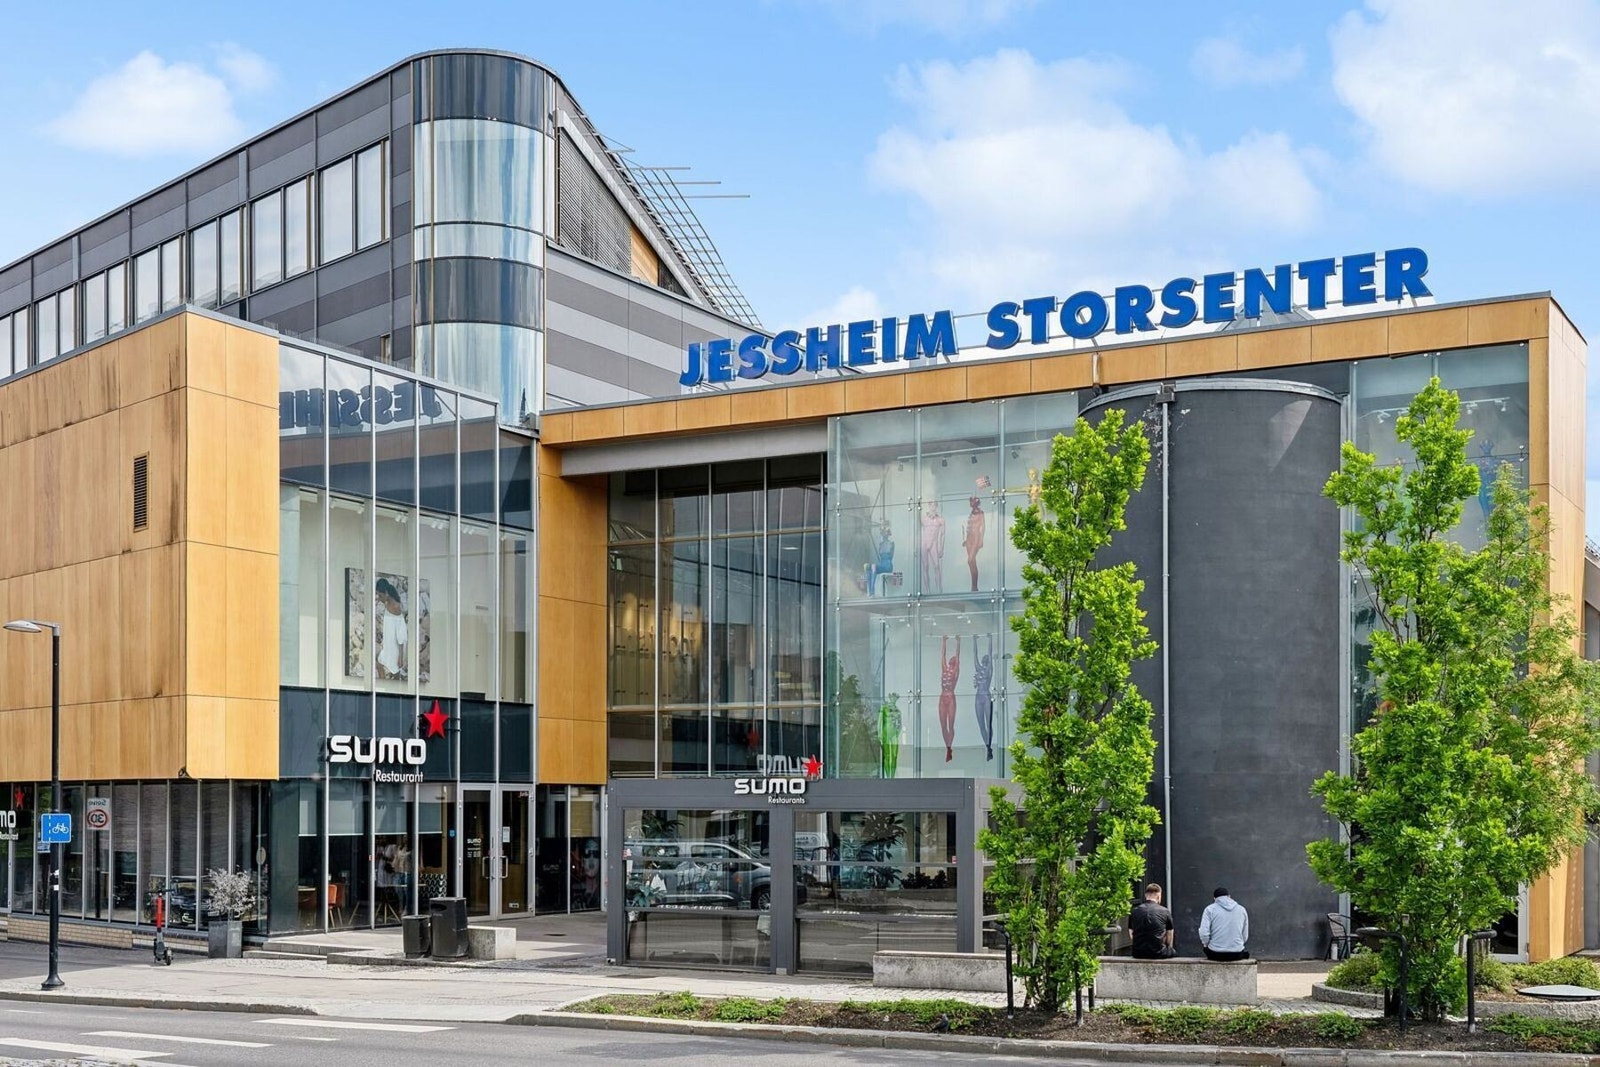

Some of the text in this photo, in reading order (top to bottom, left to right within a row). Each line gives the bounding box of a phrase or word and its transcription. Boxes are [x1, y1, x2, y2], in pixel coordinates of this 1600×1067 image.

[680, 247, 1433, 387] JESSHEIM STORSENTER
[329, 735, 427, 765] SUMO
[375, 769, 424, 783] Restaurant
[734, 777, 806, 795] SUMO
[767, 795, 806, 805] Restaurants
[0, 810, 17, 829] MO
